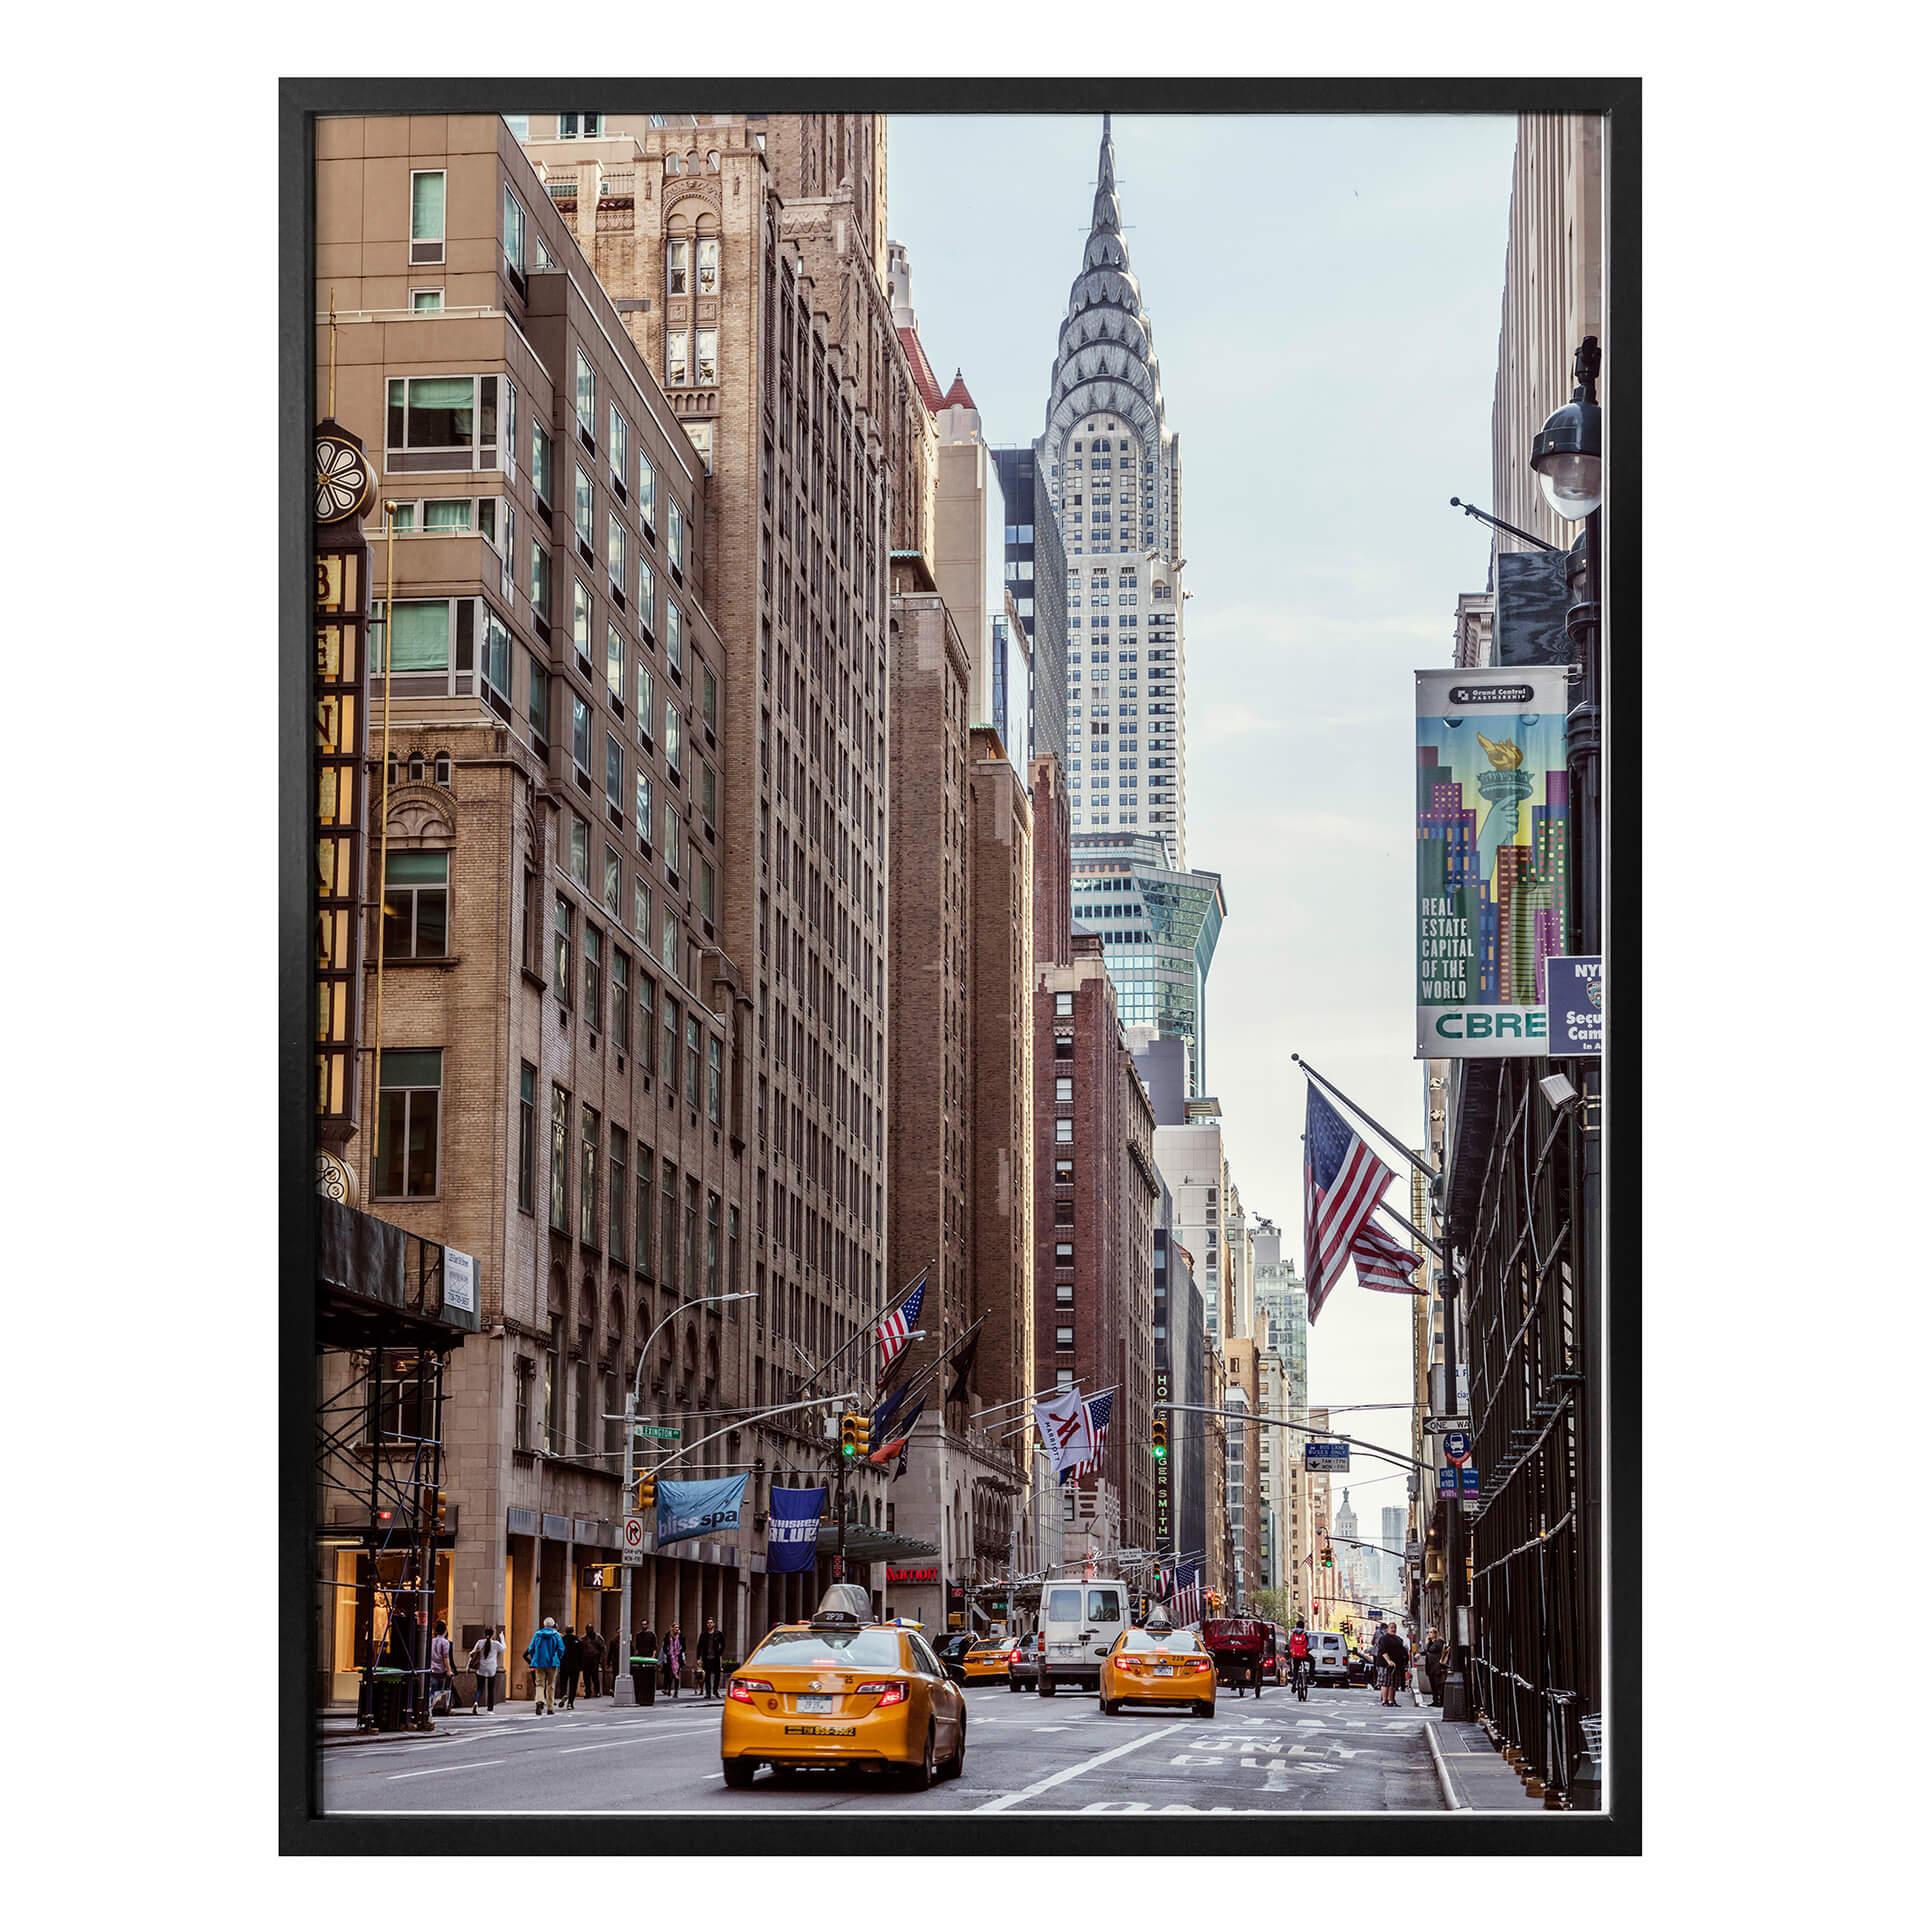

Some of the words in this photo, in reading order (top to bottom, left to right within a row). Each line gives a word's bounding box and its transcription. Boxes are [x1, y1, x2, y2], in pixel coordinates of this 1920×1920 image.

[1498, 687, 1526, 696] Central
[1422, 897, 1454, 916] REAL
[1422, 918, 1468, 937] ESTATE
[1422, 938, 1475, 958] CAPITAL
[1422, 959, 1438, 978] OF
[1441, 959, 1466, 978] THE
[1422, 980, 1467, 999] WORLD
[1434, 1012, 1547, 1039] CBRE
[1157, 1375, 1168, 1432] HOTE
[1430, 1421, 1449, 1430] ONE
[1456, 1420, 1470, 1429] WA
[1045, 1421, 1060, 1462] MARRIOTT
[1158, 1489, 1168, 1535] SMITH
